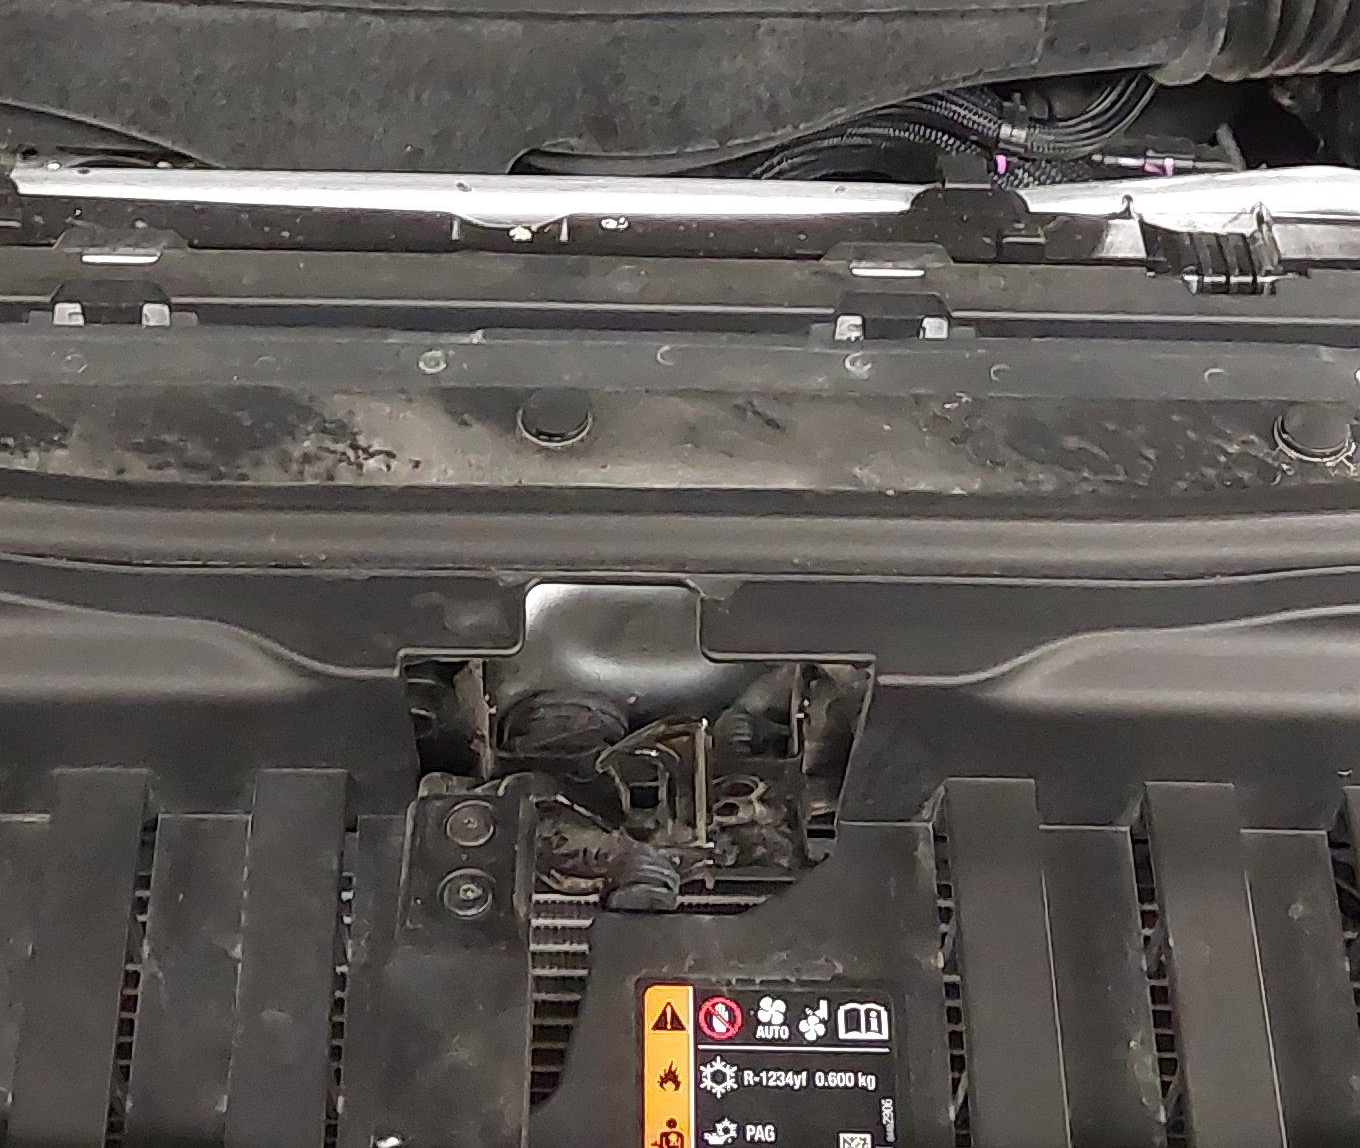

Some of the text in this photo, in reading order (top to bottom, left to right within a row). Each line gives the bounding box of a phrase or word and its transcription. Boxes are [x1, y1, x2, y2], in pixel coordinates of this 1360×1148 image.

[755, 1025, 790, 1040] AUTO
[743, 1071, 877, 1091] R-1234yf 0.600 kg
[745, 1125, 776, 1143] PAG
